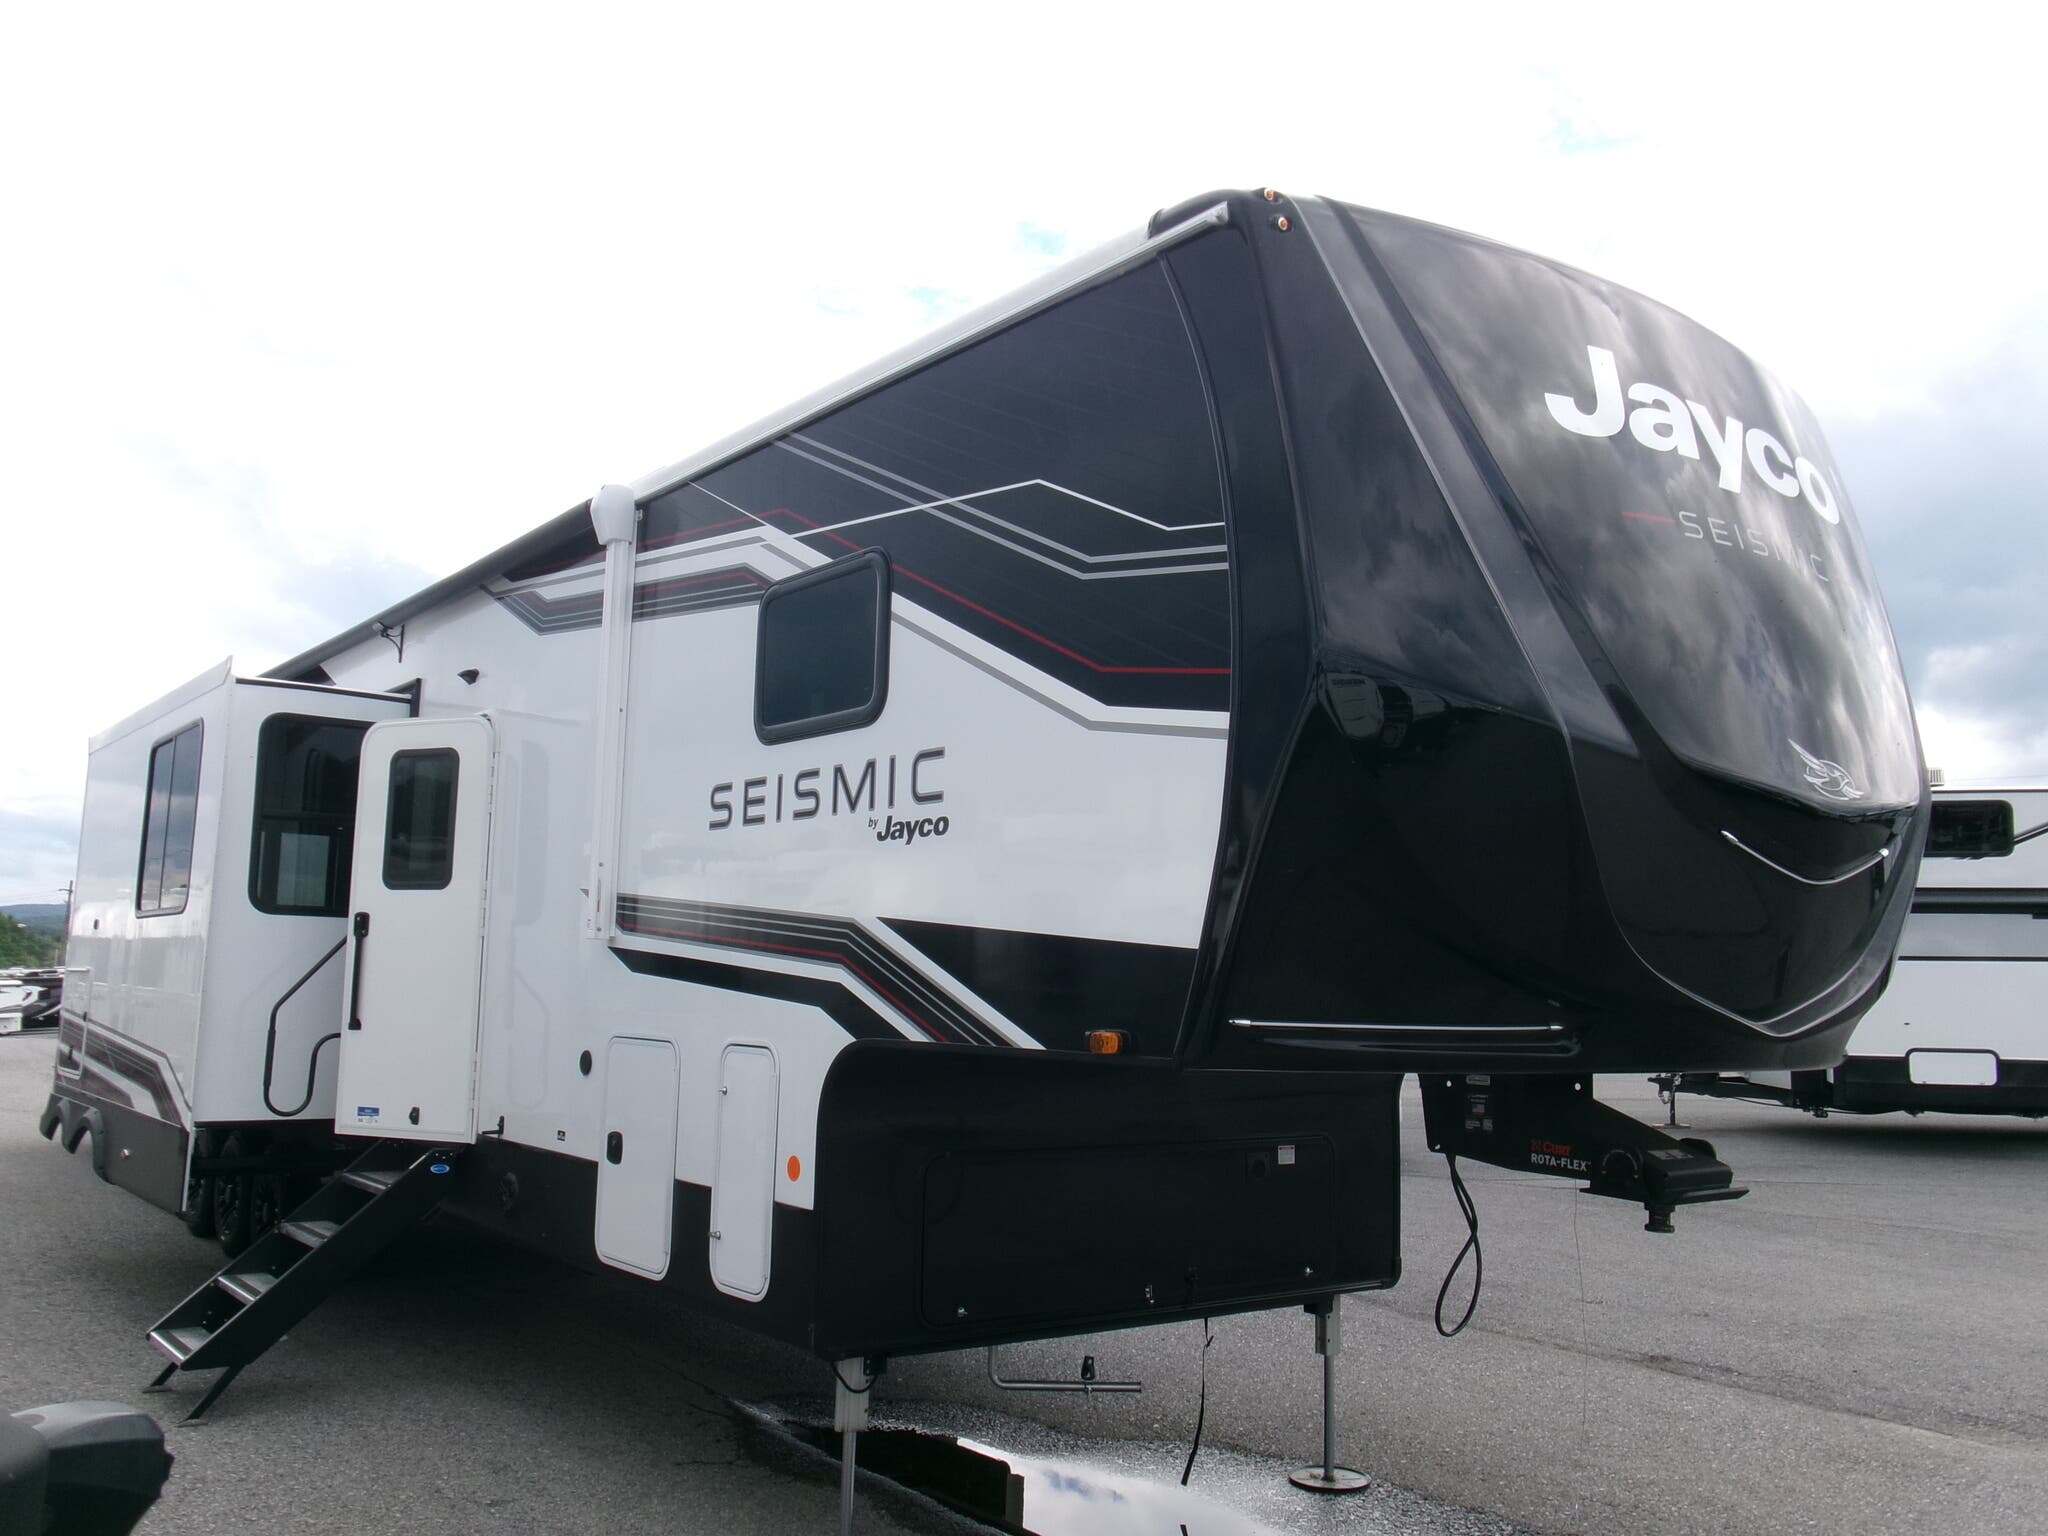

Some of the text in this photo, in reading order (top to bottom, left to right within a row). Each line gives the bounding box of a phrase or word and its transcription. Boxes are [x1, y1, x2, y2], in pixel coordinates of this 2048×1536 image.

[1544, 345, 1840, 525] Jayco
[708, 746, 946, 831] SEISMIC
[868, 815, 950, 846] by Jayco
